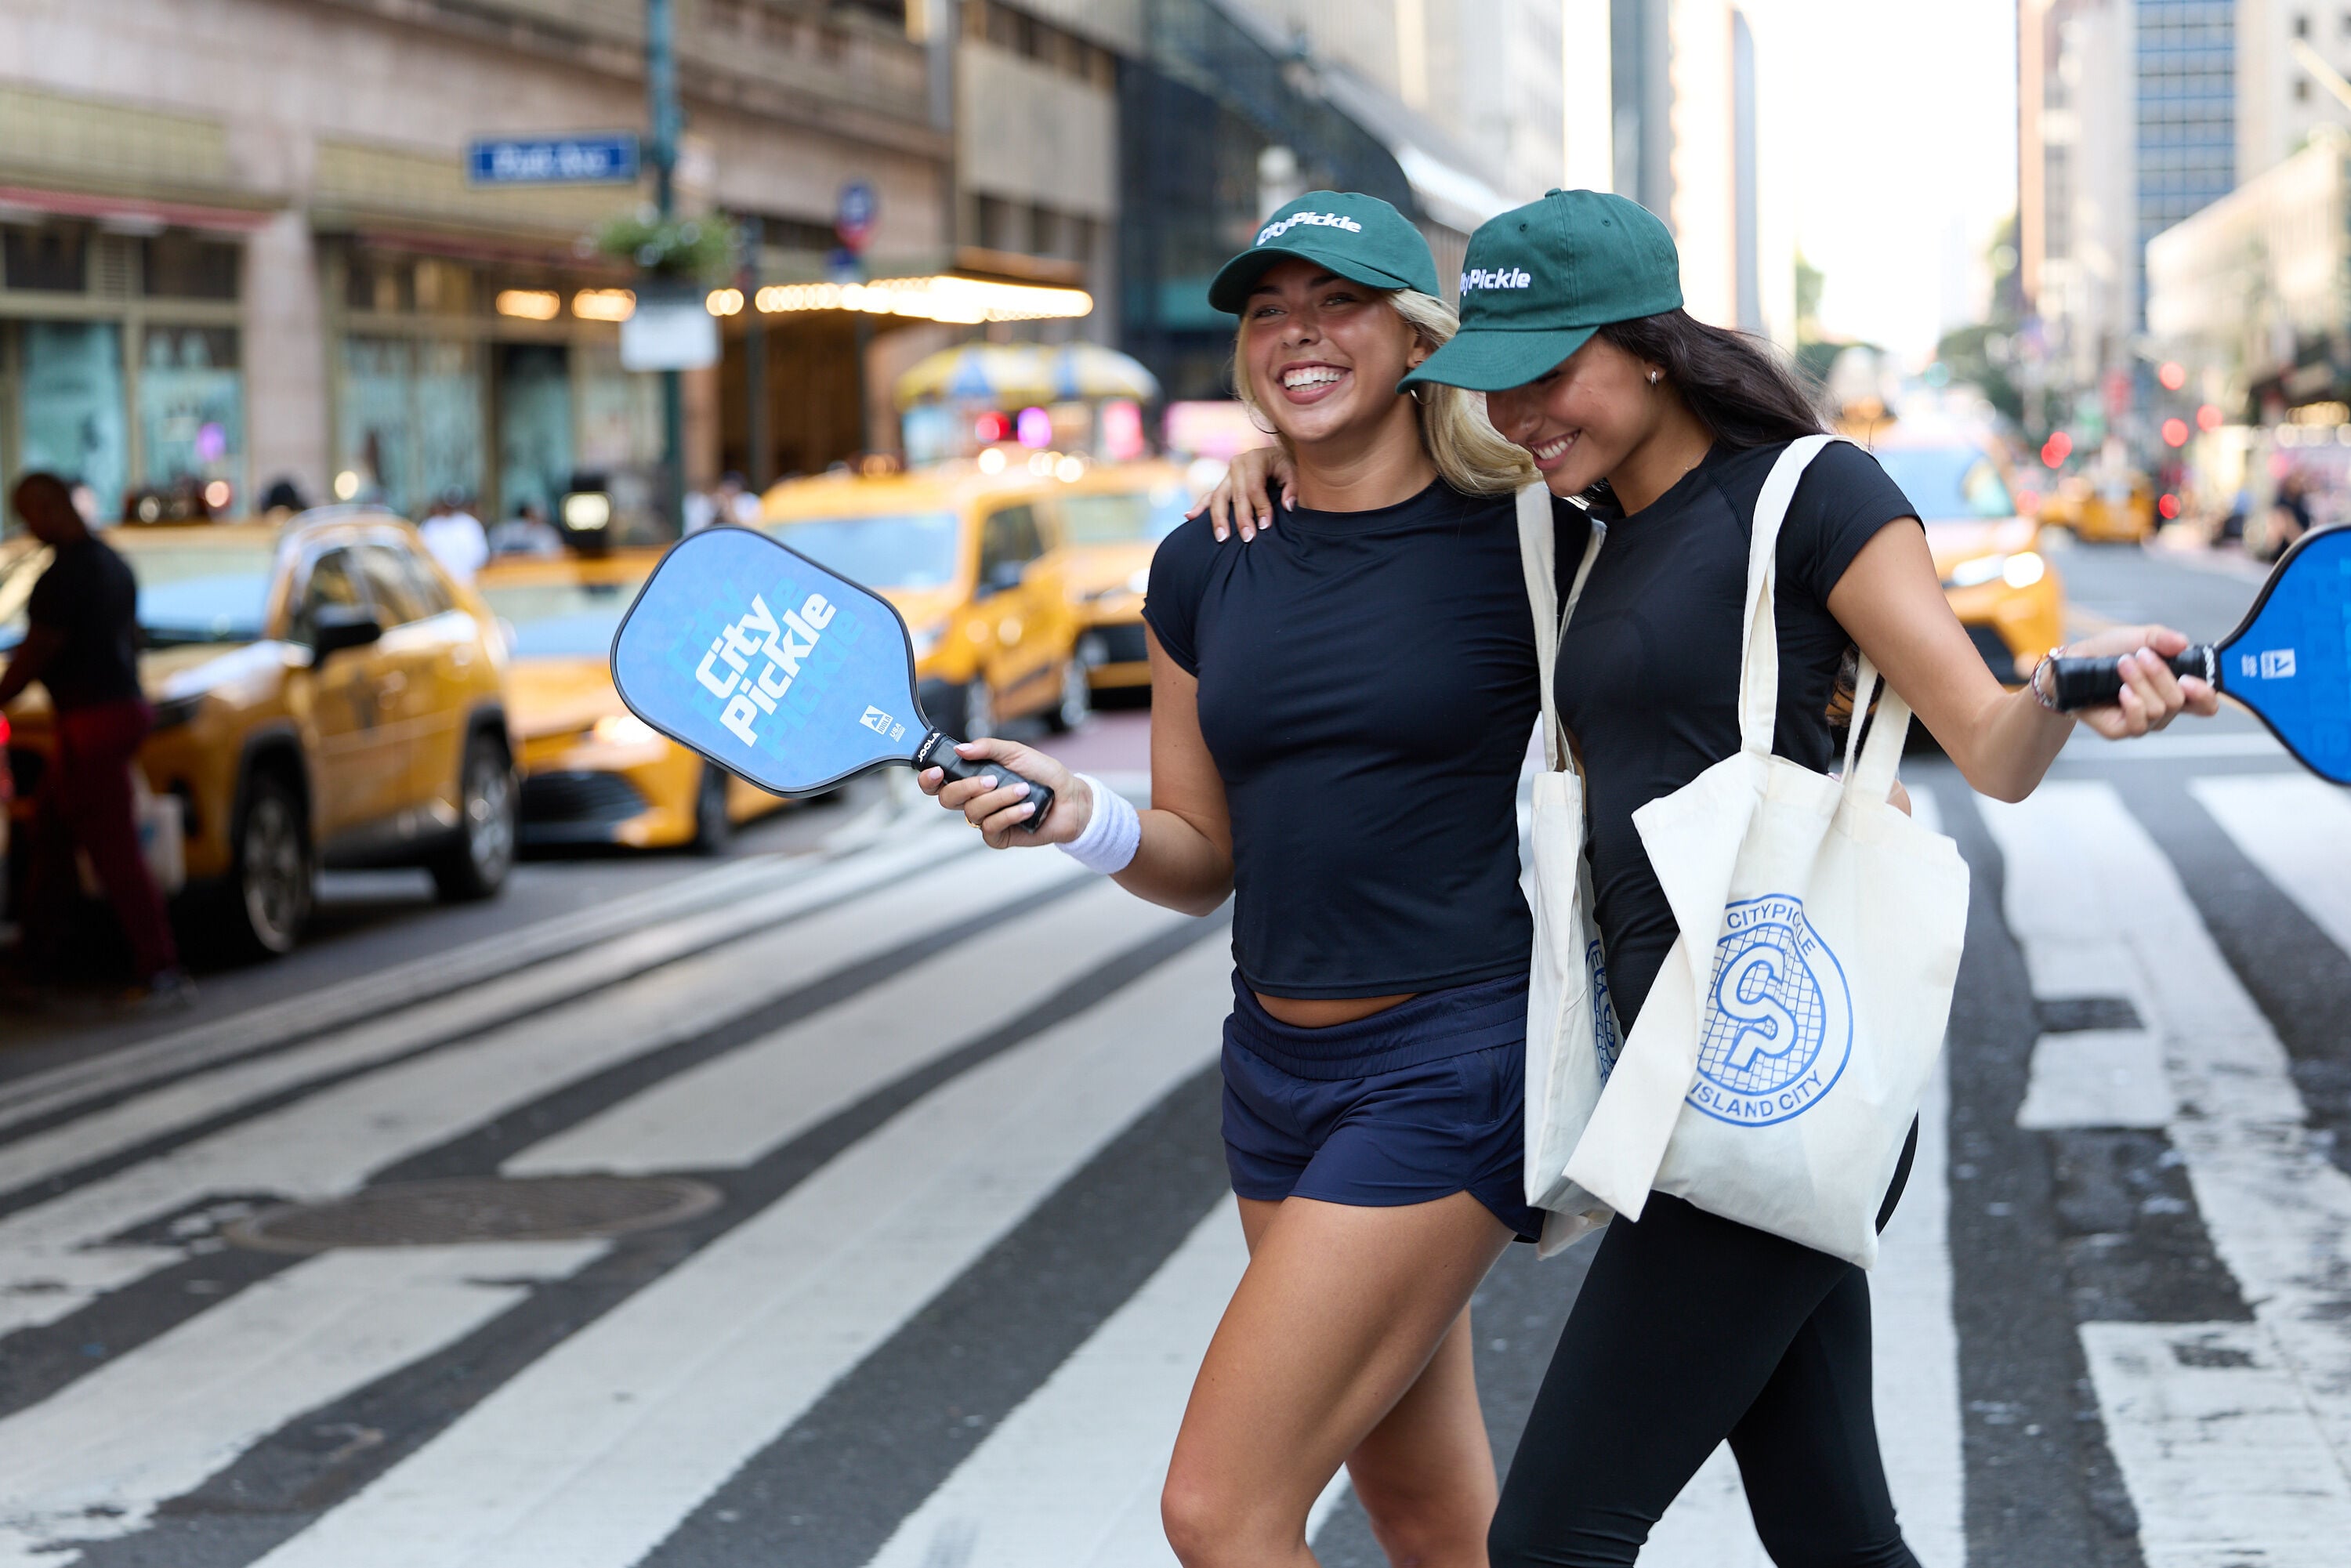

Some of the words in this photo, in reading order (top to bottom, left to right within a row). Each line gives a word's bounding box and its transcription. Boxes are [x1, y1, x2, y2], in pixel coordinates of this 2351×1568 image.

[1460, 267, 1531, 296] tyPickle
[696, 592, 781, 699] City
[719, 593, 837, 748] Pickle
[877, 715, 892, 733] JOOLA
[889, 722, 901, 737] USA
[918, 732, 940, 762] JOOLA
[1690, 1081, 1773, 1117] ISLAND
[1779, 1070, 1822, 1110] CITY
